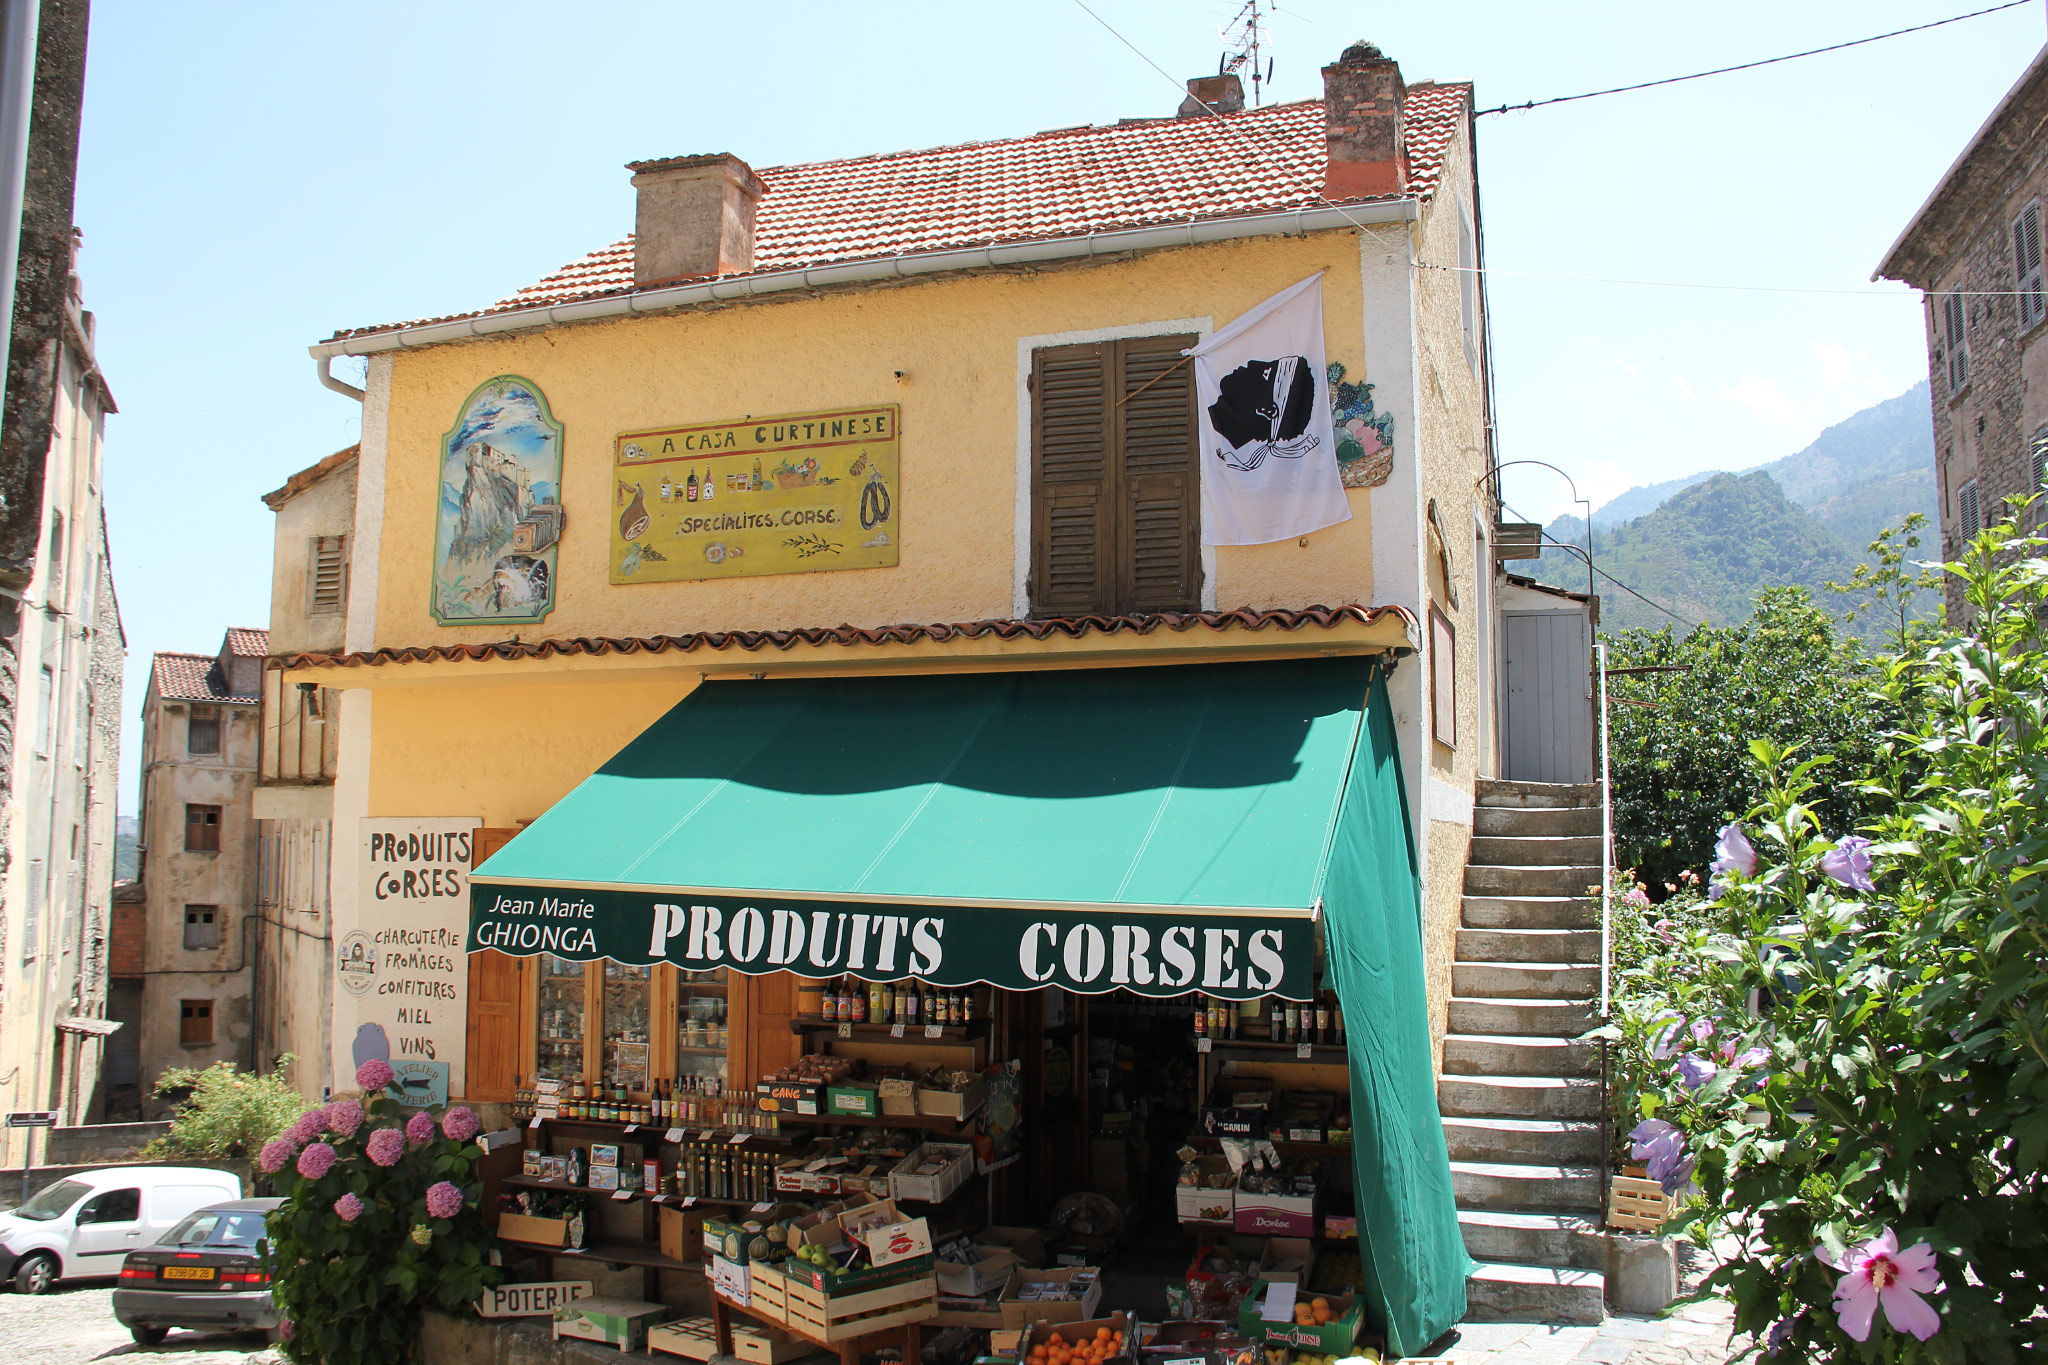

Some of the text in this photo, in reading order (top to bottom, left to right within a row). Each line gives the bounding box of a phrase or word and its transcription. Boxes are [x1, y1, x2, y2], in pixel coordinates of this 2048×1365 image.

[662, 416, 887, 453] A CASA CURTINESE
[371, 832, 471, 863] PRODUITS
[375, 869, 461, 900] CORSES
[489, 895, 595, 919] Jean Marie
[375, 928, 460, 947] CHARCUTERIE
[476, 921, 597, 953] GHIONGA
[649, 903, 945, 976] PRODUITS
[385, 953, 454, 973] FROMAGES
[1019, 922, 1284, 991] CORSES
[378, 979, 456, 1000] CONFITURES
[397, 1008, 432, 1024] MIEL
[400, 1037, 436, 1060] VINS
[397, 1063, 439, 1080] ATELIER
